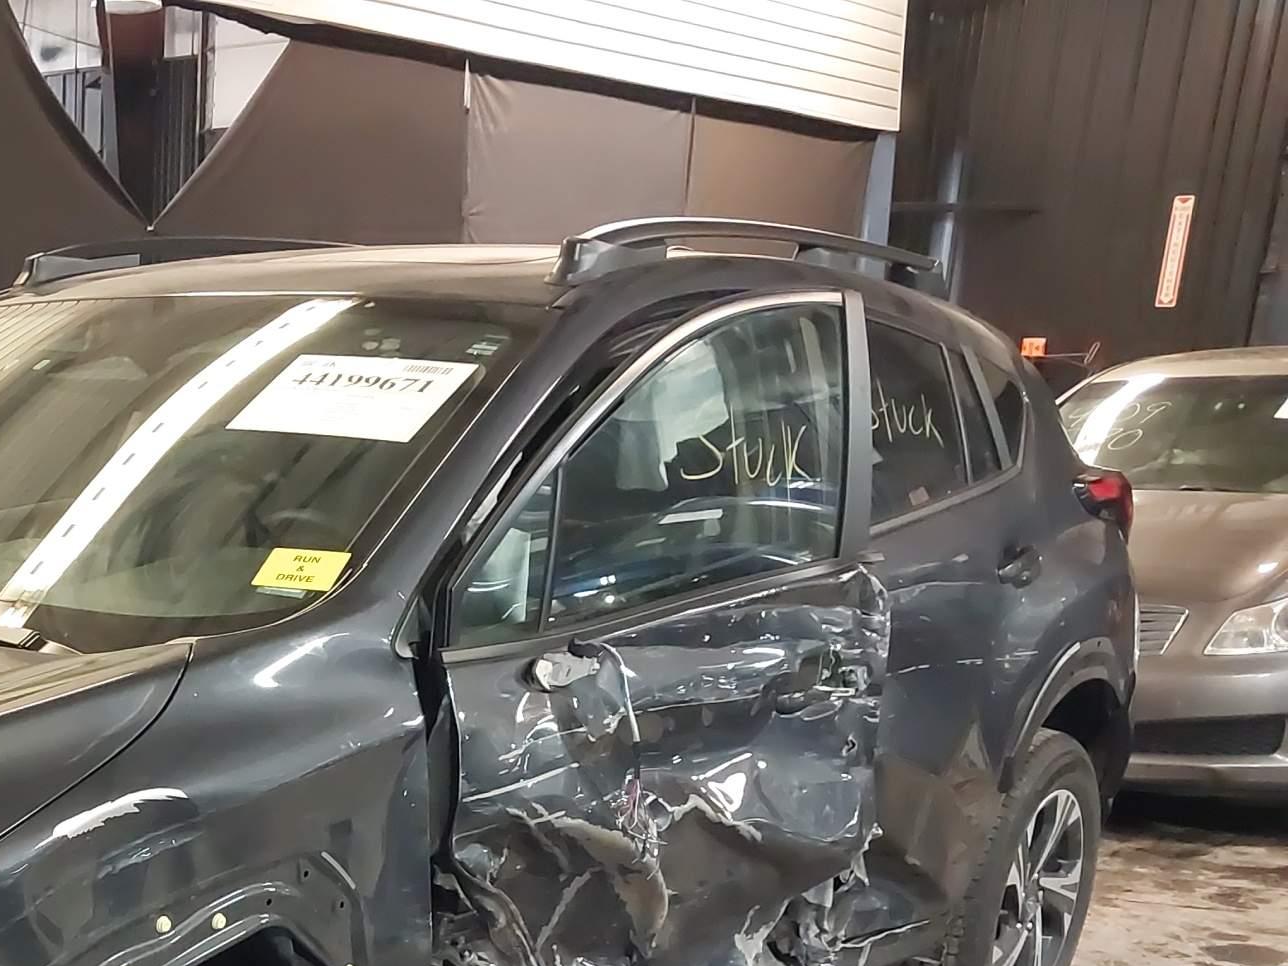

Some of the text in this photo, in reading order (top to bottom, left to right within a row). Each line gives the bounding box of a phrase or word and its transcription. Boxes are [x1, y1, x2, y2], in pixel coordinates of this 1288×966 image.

[292, 372, 435, 393] 44199671
[293, 555, 322, 564] RUN
[275, 573, 316, 583] DRIVE
